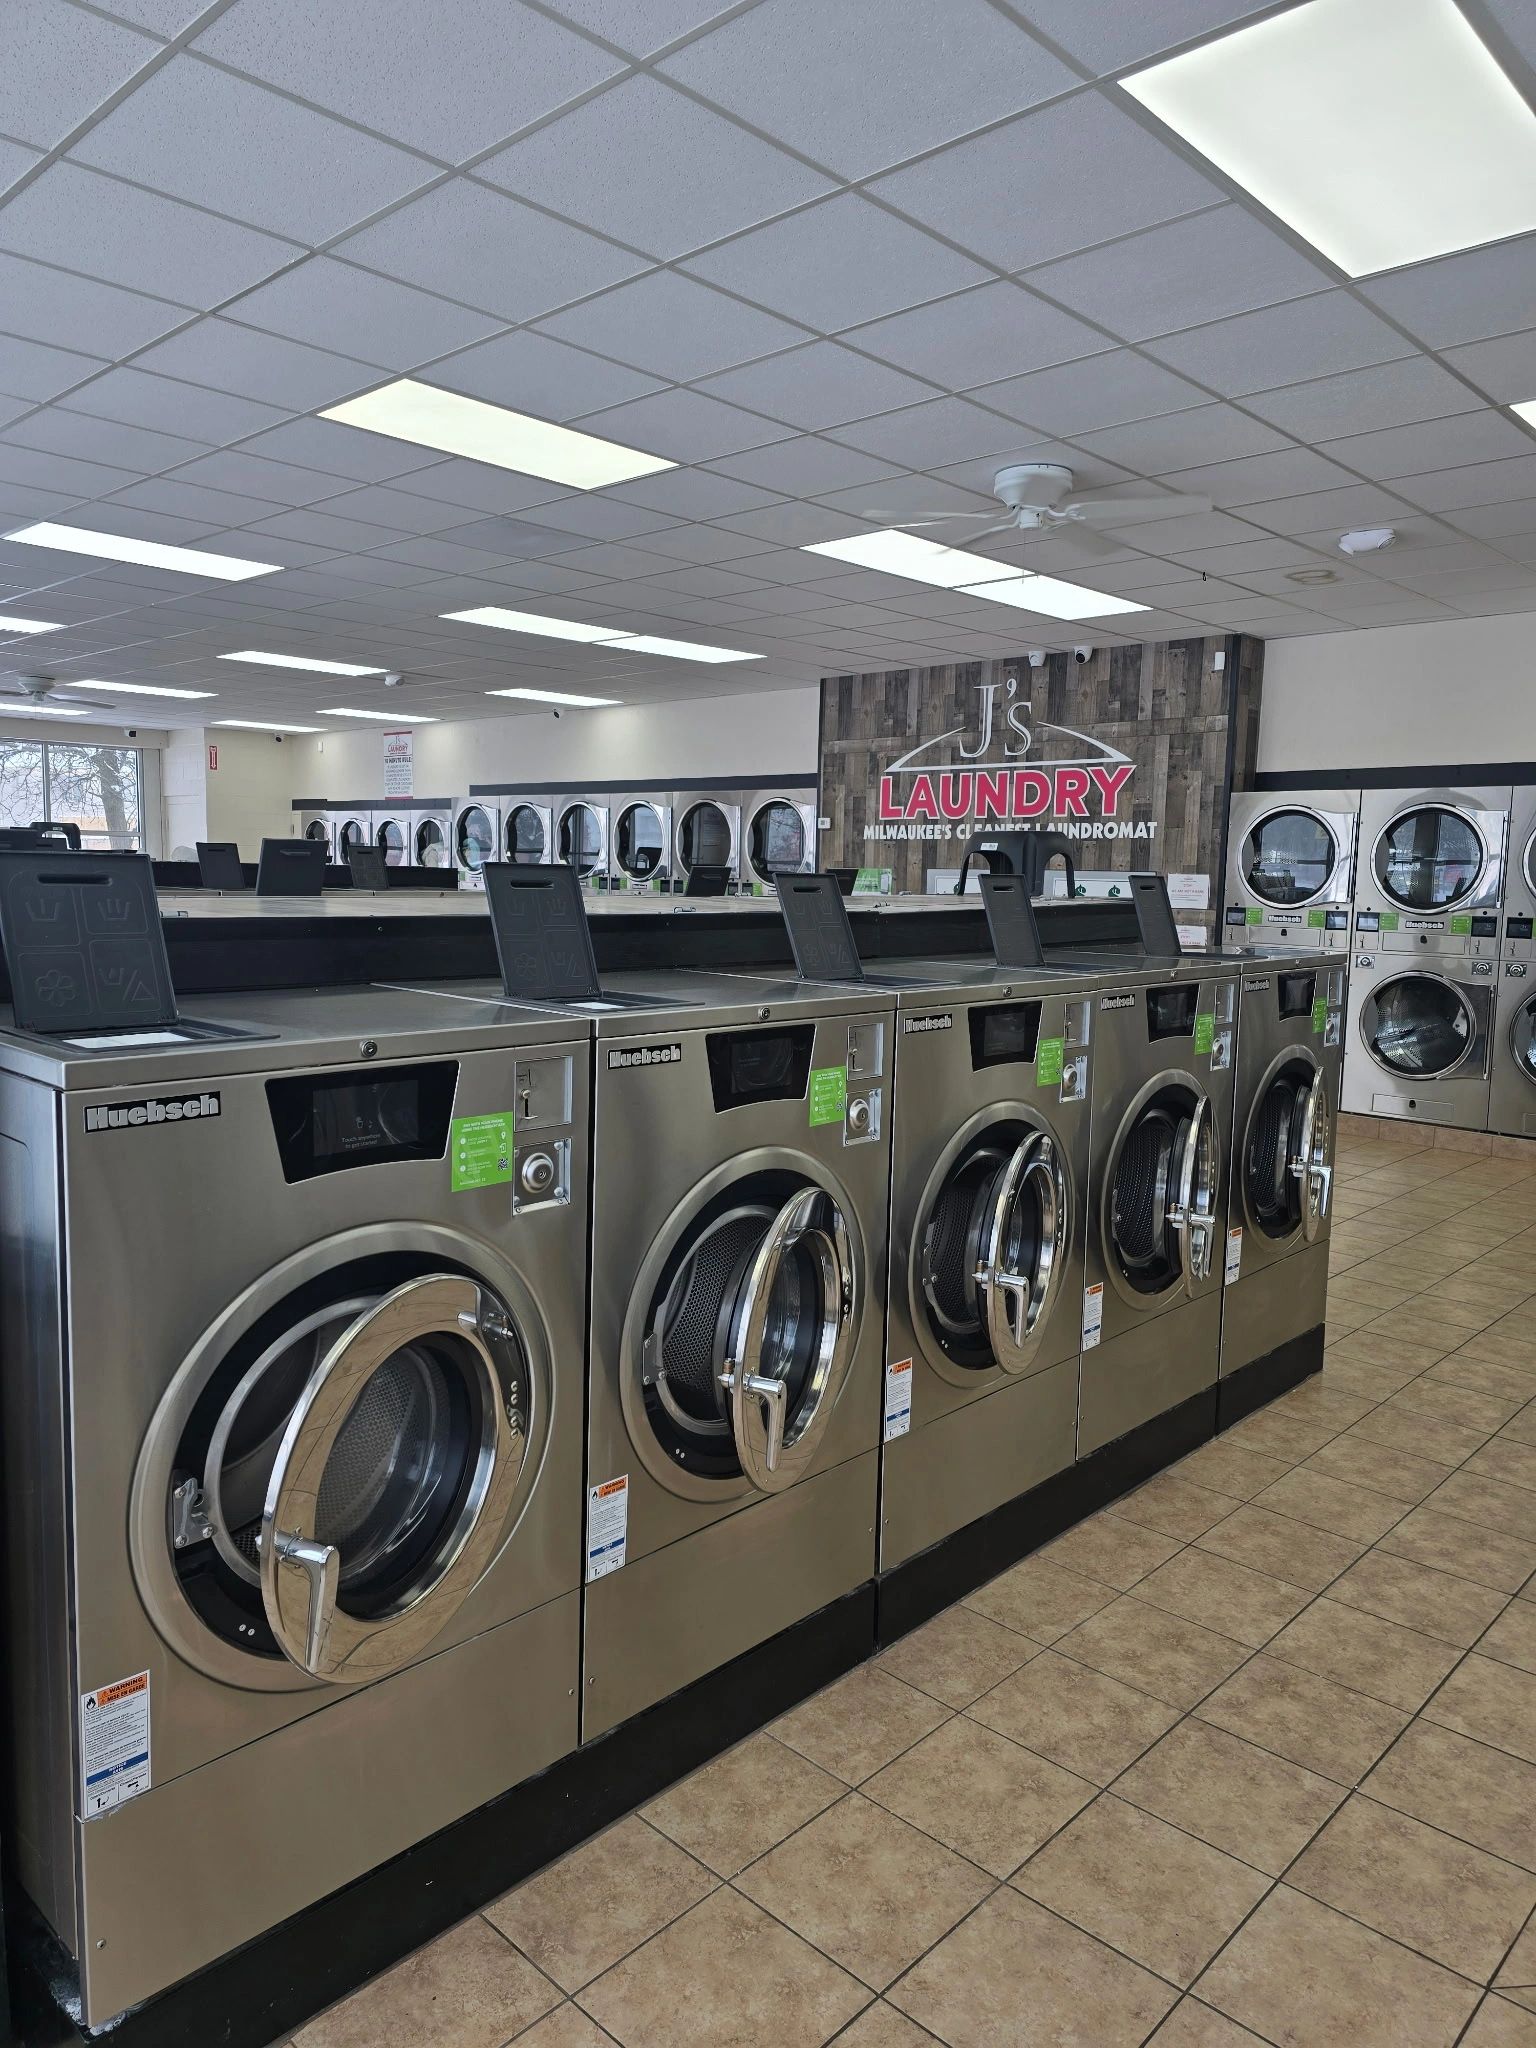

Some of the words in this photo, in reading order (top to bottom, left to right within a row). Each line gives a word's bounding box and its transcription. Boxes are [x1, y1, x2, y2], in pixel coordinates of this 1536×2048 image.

[959, 678, 1032, 757] J's
[879, 765, 1137, 820] LAUNDRY
[863, 824, 952, 840] MILWAUKEE'S
[905, 1014, 952, 1033] Huebsch
[609, 1045, 681, 1068] Huebsch
[86, 1094, 219, 1131] Huebsch
[109, 1676, 143, 1694] WARNING
